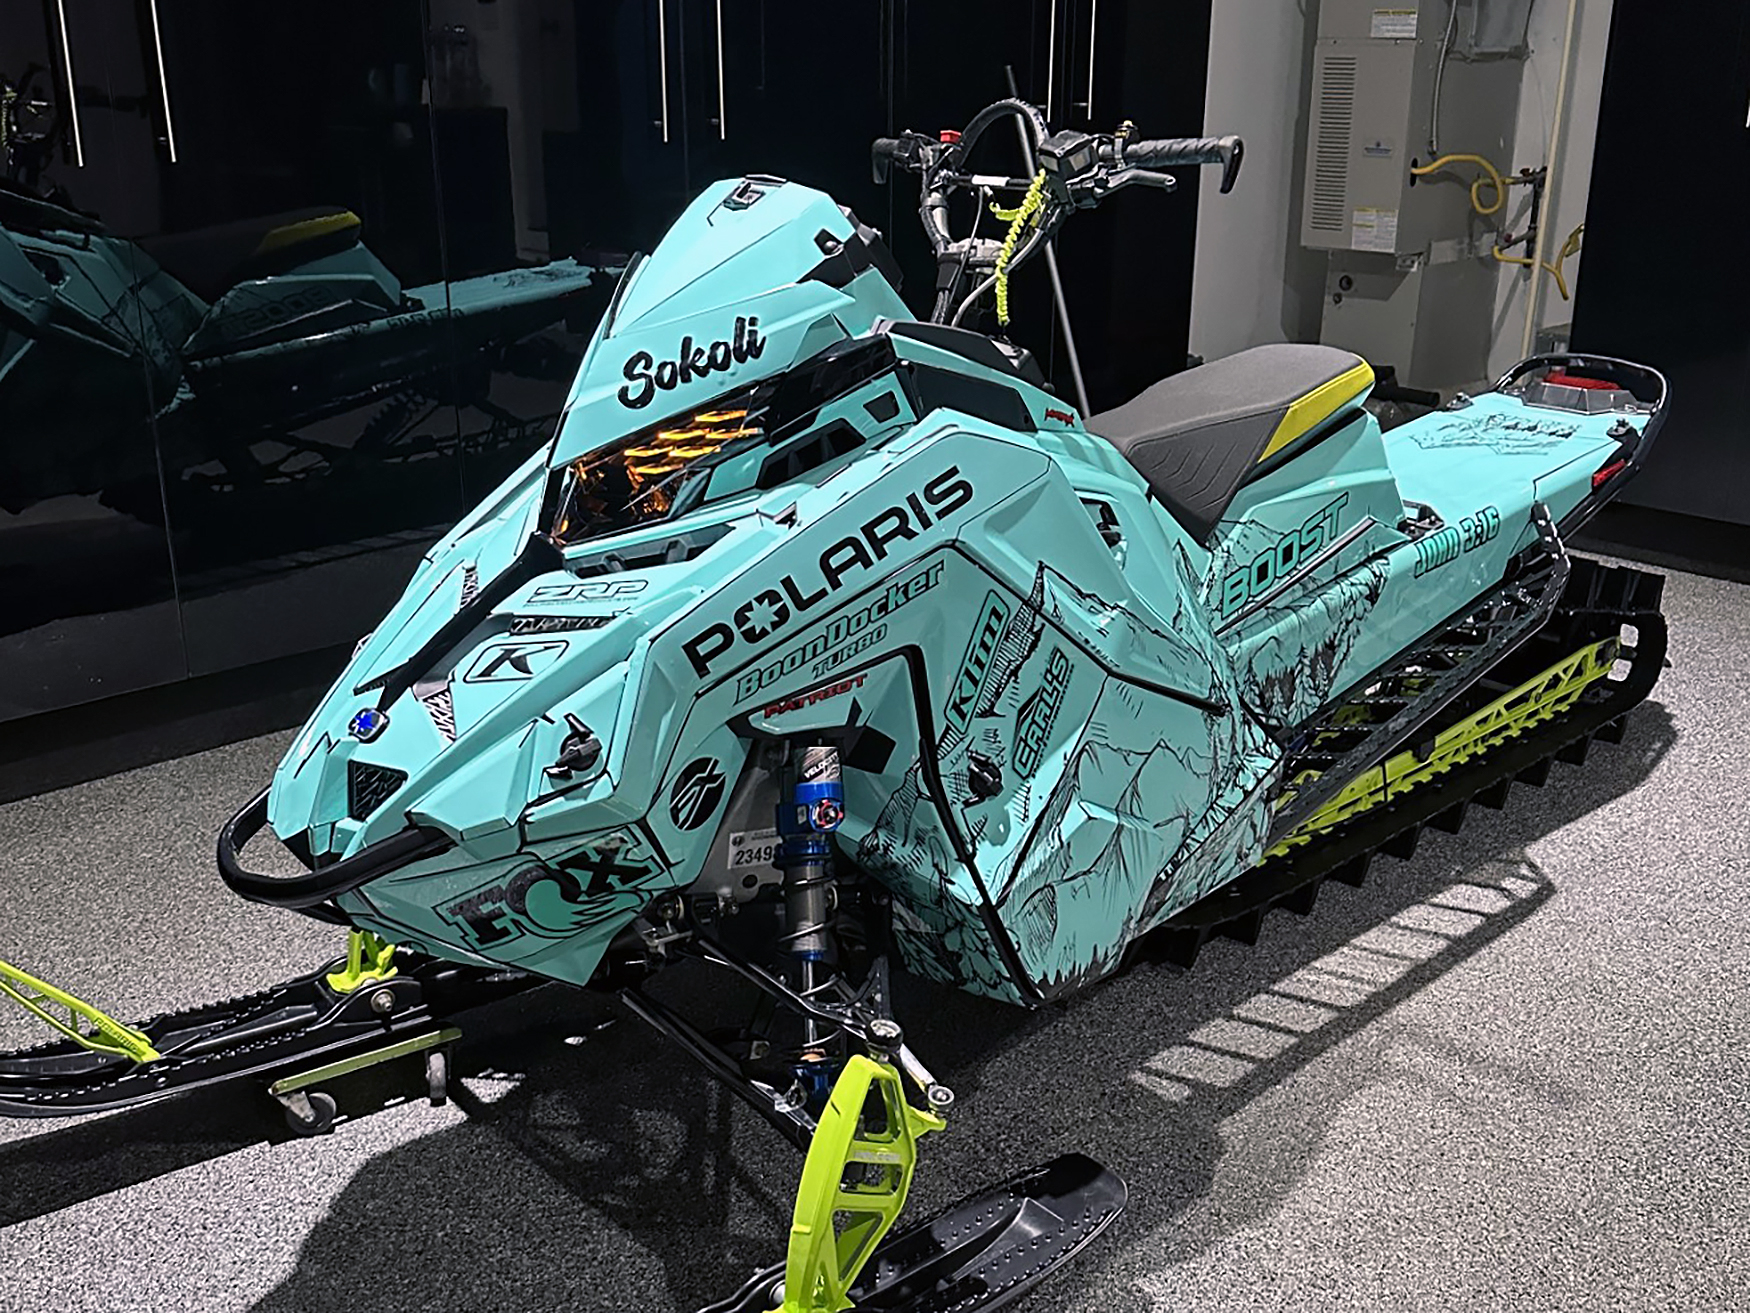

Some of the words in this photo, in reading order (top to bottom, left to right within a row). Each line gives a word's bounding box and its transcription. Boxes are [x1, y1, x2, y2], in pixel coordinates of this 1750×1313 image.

[617, 316, 767, 410] Sokoli
[681, 465, 974, 680] POLARIS
[1221, 491, 1349, 621] BOOST
[1413, 526, 1461, 579] JOHN
[1459, 505, 1500, 554] 3:16
[526, 579, 649, 603] ZRP
[732, 558, 945, 707] BoonDocker
[811, 623, 888, 680] TURBO
[763, 672, 869, 719] PATRIOT
[435, 827, 662, 950] FOX
[94, 1016, 140, 1053] POLARIS
